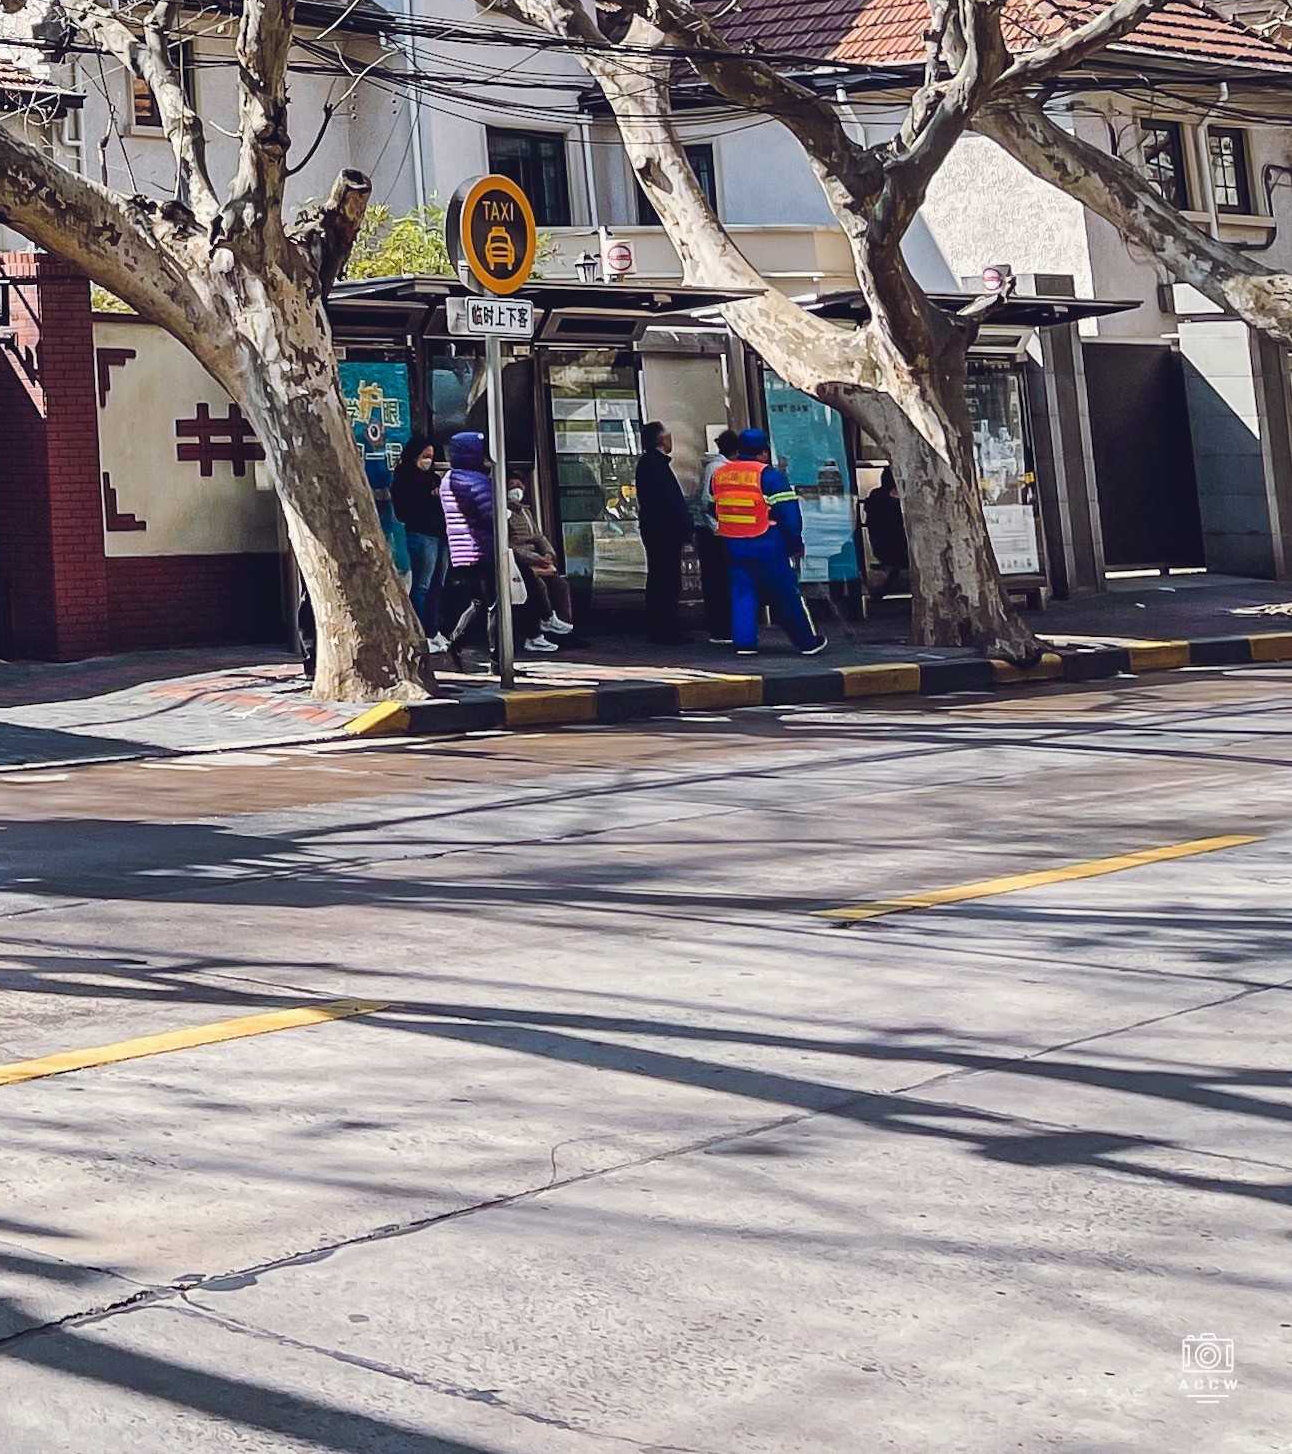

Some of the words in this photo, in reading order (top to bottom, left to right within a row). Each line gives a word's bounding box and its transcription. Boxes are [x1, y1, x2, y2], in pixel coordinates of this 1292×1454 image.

[482, 200, 514, 222] TAXI
[471, 303, 528, 328] 临时上下客
